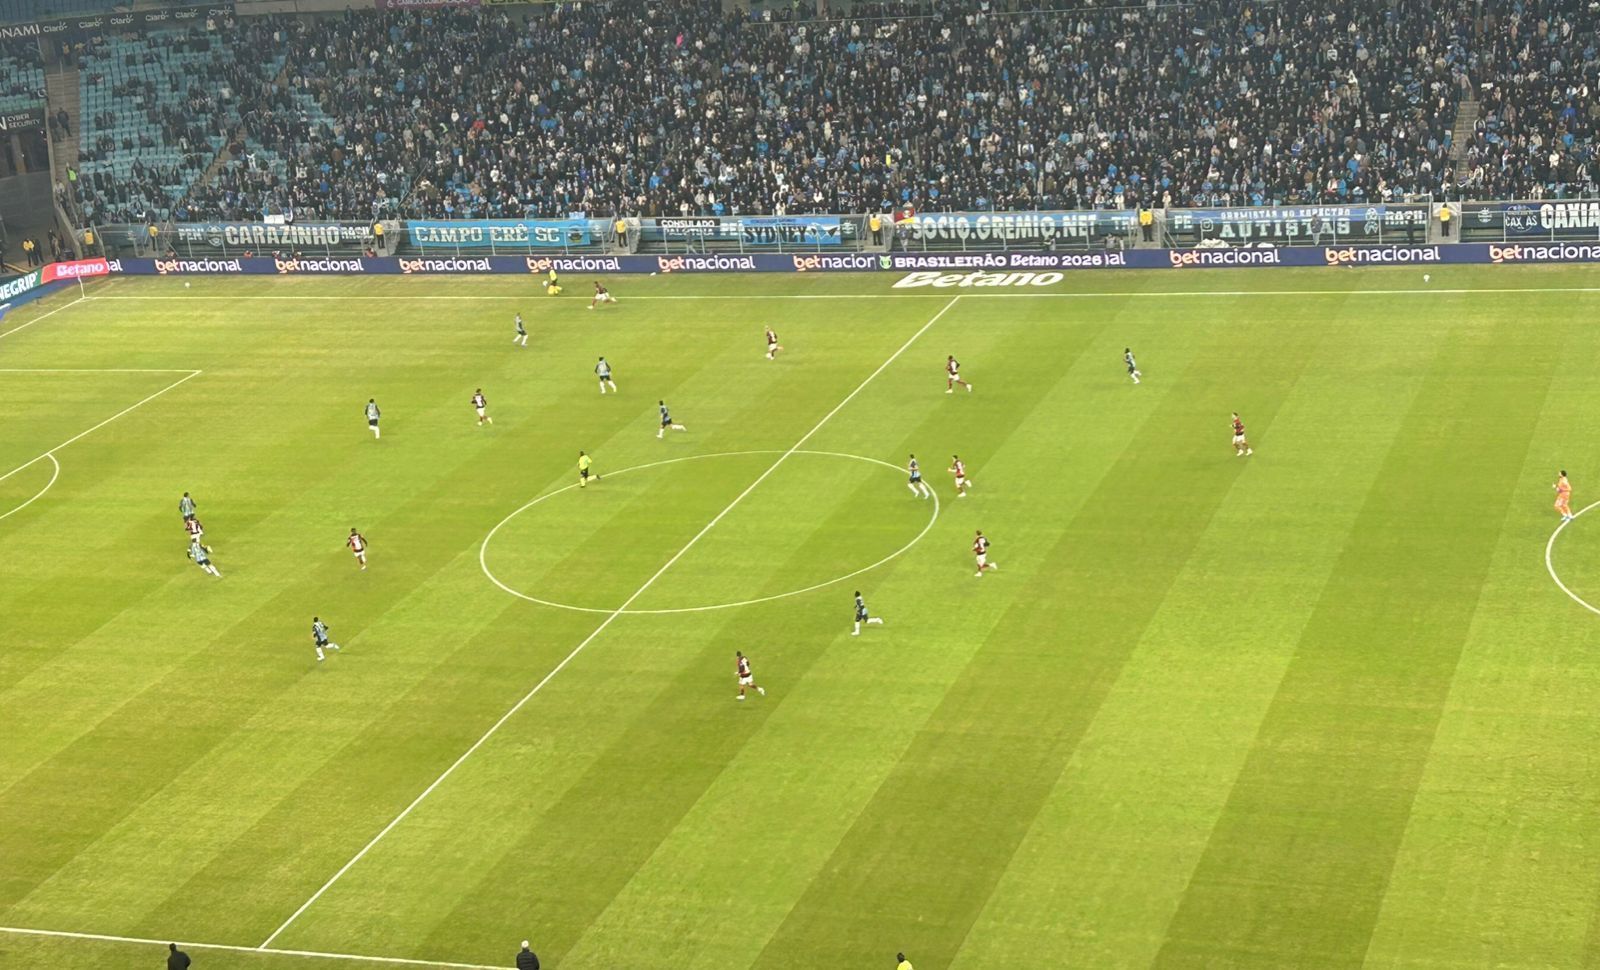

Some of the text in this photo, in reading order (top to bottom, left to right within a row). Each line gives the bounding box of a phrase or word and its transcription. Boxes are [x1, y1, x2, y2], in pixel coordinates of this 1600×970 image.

[110, 16, 132, 25] Claro
[145, 13, 167, 21] Claro
[175, 10, 196, 18] Claro
[0, 24, 40, 38] NAMI
[43, 22, 66, 33] Claro
[79, 19, 101, 29] Claro
[661, 219, 716, 228] CONSULADO
[1220, 218, 1350, 238] AUTISTAS
[1505, 215, 1538, 230] CAXAS
[225, 225, 340, 245] CARAZINHO
[340, 226, 374, 239] RASIL
[415, 223, 560, 242] CAMPO ERÊ SC
[745, 226, 808, 243] SYDNEY
[894, 253, 1102, 267] BRASILEIRÃO Betano 2026
[1170, 248, 1280, 267] betnacional
[1325, 245, 1440, 265] betnacional
[1489, 243, 1600, 263] betnaciona
[56, 263, 104, 277] Betano
[154, 258, 242, 273] betnacional
[275, 257, 364, 273] betnacional
[399, 257, 492, 273] betnacional
[527, 256, 621, 273] betnacional
[658, 255, 755, 272] betnacional
[892, 270, 1064, 289] Betano
